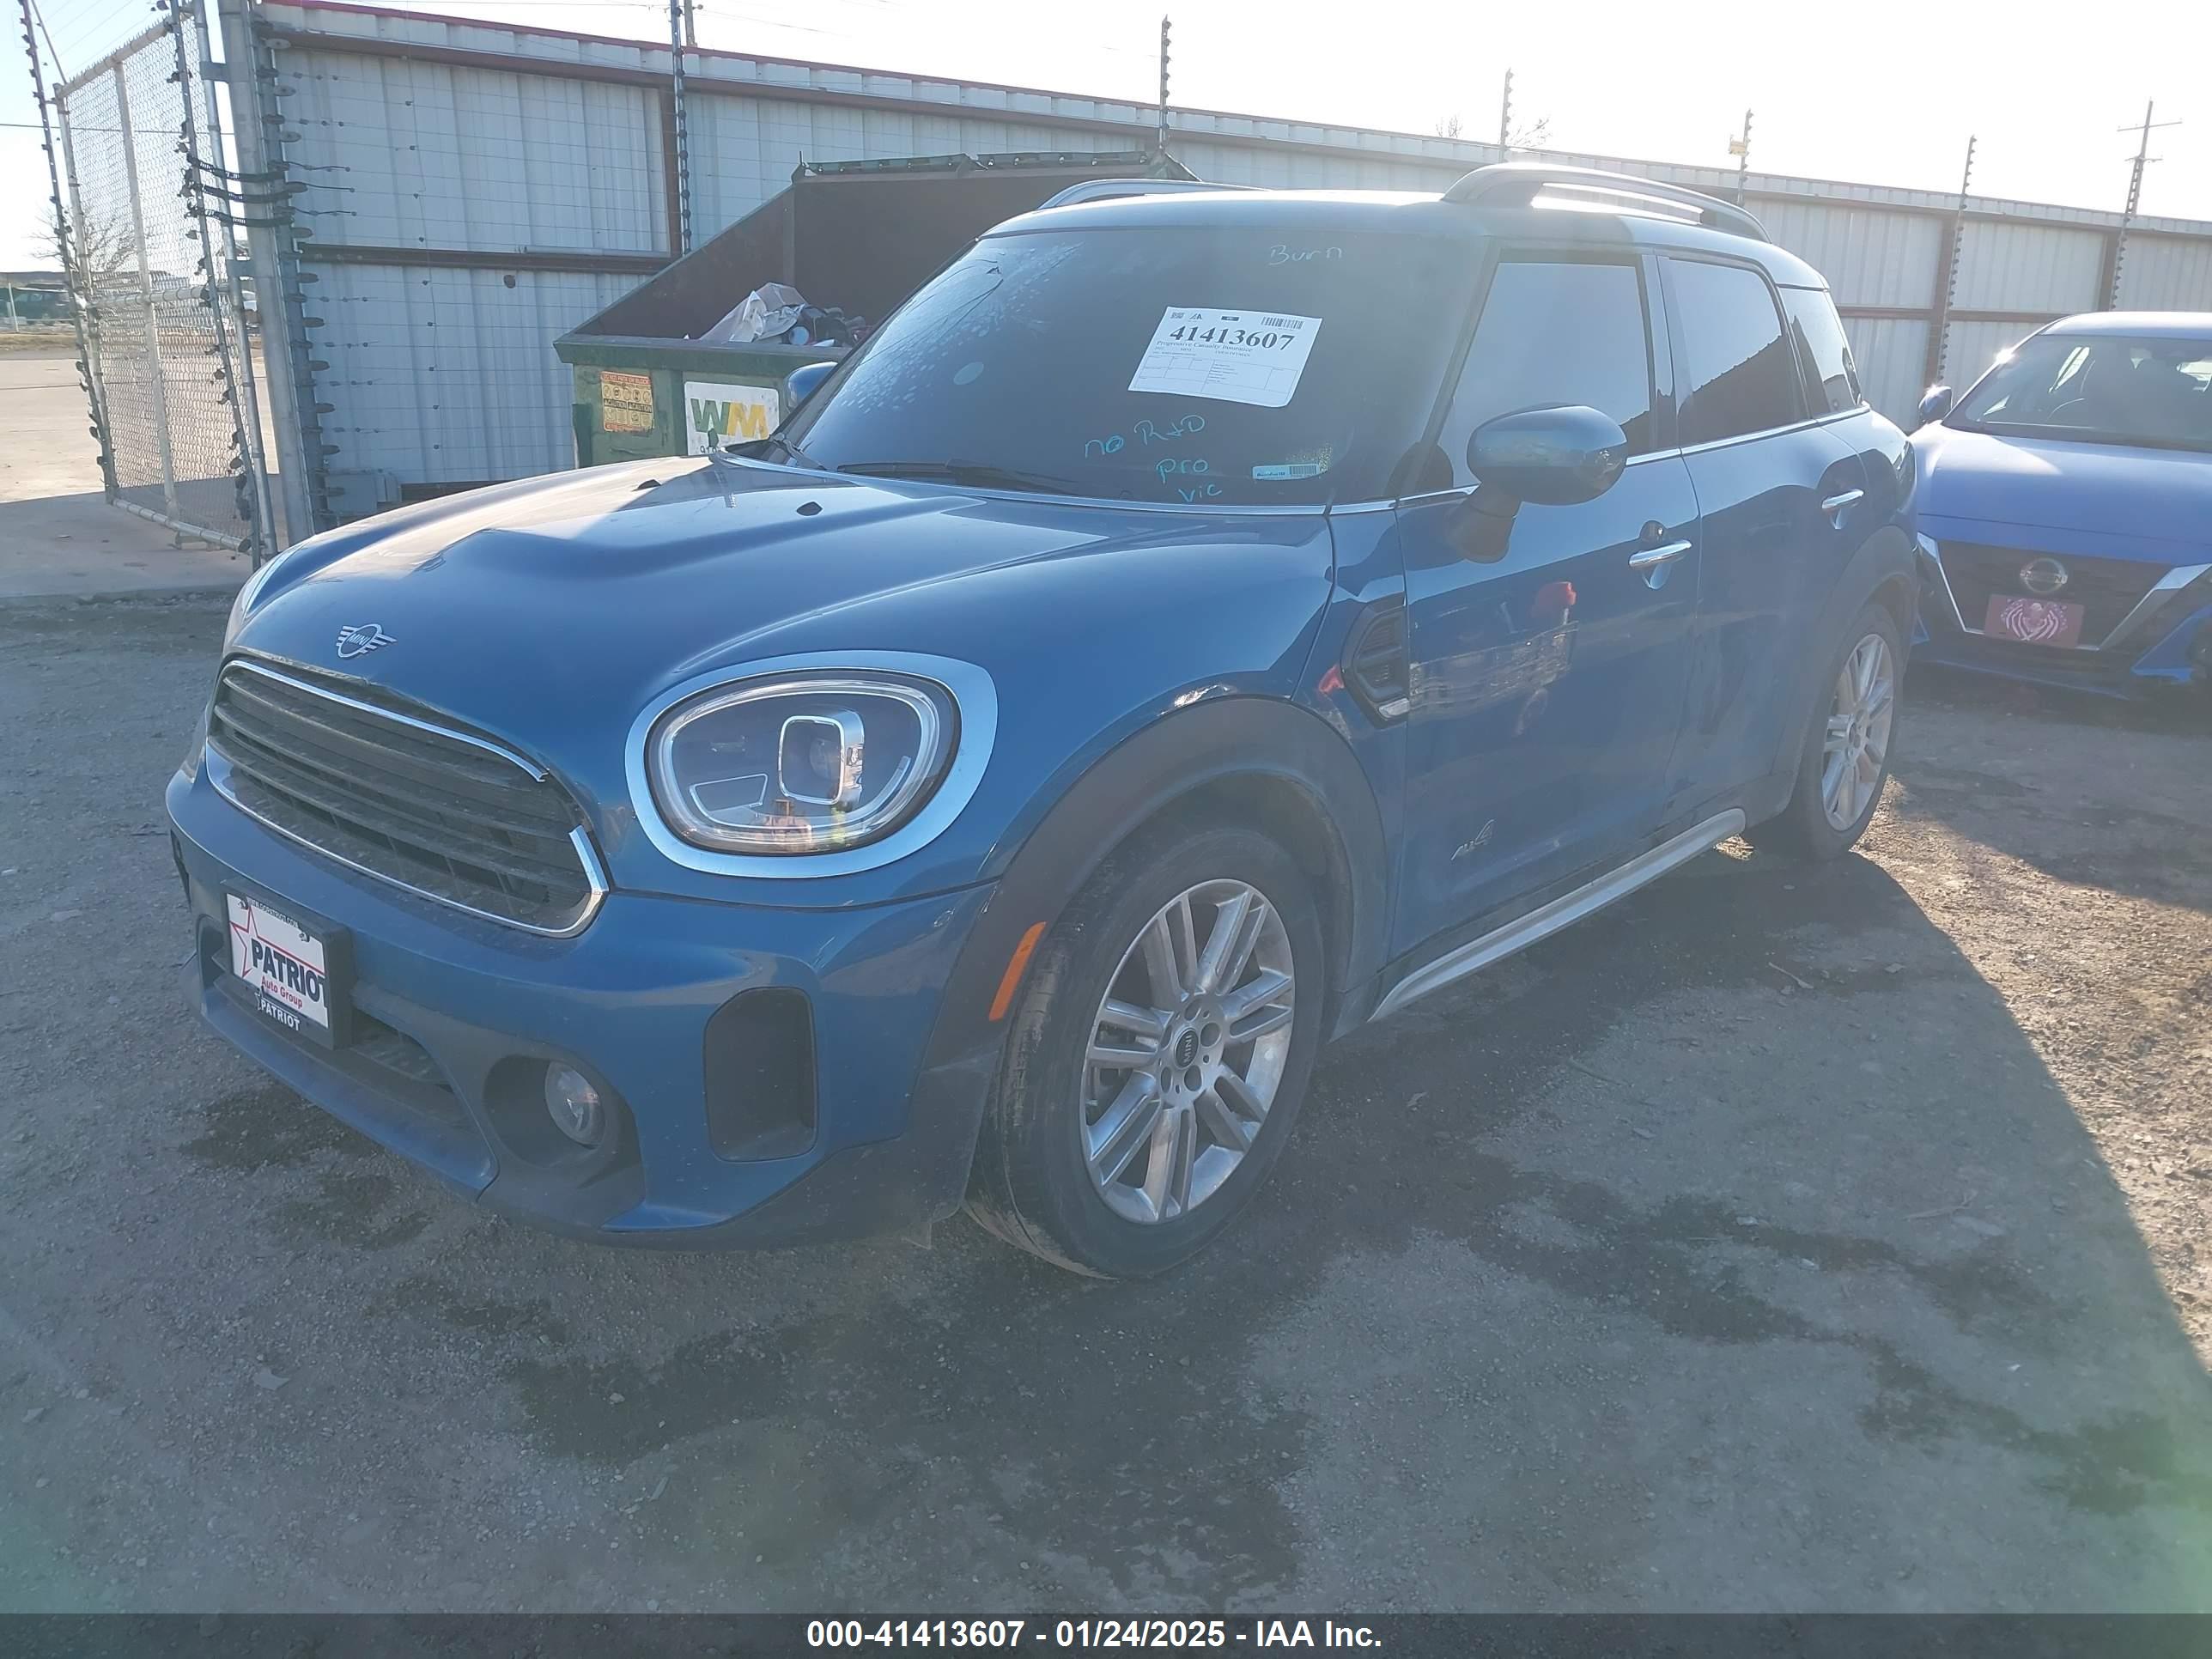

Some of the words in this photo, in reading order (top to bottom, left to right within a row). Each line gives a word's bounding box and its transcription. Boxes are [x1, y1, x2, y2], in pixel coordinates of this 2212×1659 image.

[1268, 244, 1342, 266] Burn
[1169, 325, 1296, 351] 41413607
[1193, 342, 1221, 350] Casualty
[690, 398, 769, 440] WM
[251, 938, 327, 1008] PATRIOT
[261, 975, 278, 994] Auto
[280, 987, 303, 1008] Group
[261, 999, 301, 1030] PATRIOT
[1184, 1034, 1193, 1064] MINI
